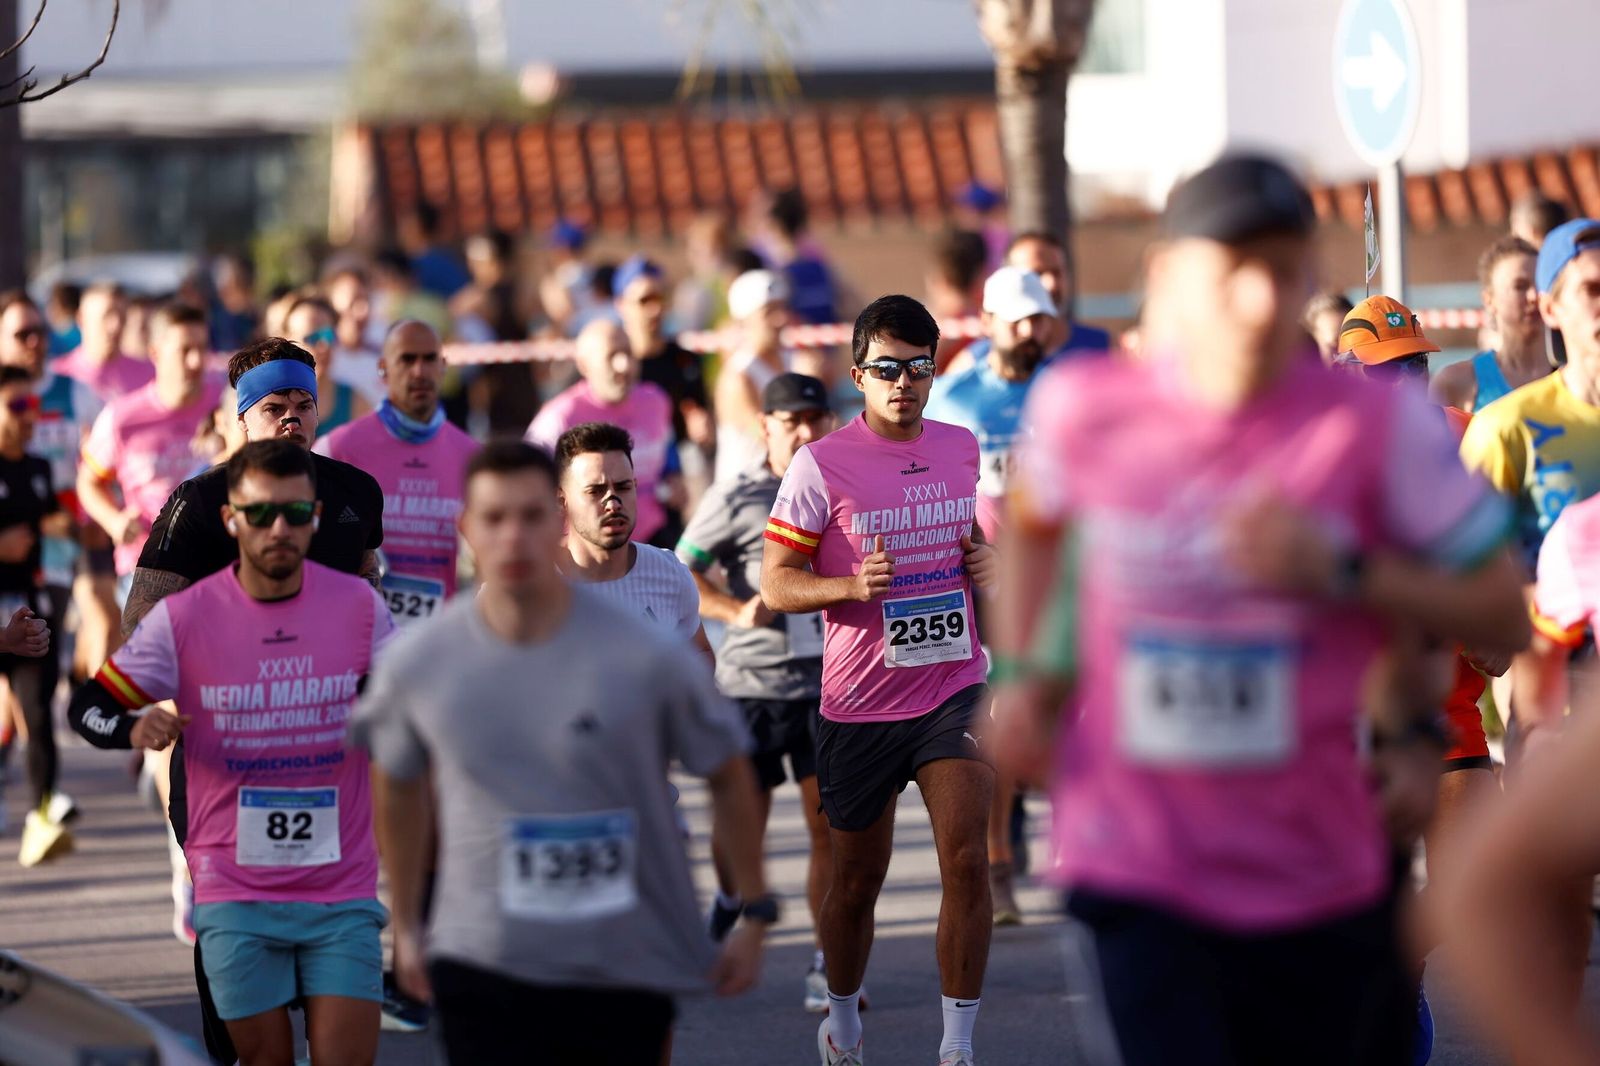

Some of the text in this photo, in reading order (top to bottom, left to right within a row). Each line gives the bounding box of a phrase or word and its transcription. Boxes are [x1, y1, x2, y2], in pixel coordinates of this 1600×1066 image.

[903, 481, 948, 503] XXXVI
[851, 493, 976, 535] MEDIA MARATÓ
[862, 525, 958, 553] INERNACIONAL
[895, 552, 934, 566] ERNATIONAL
[889, 565, 967, 588] RREMOLINO
[890, 612, 964, 646] 2359
[258, 655, 313, 680] XXXVI
[201, 668, 358, 711] MEDIA MARATÓ
[213, 707, 322, 732] INTERNACIONAL
[267, 811, 313, 840] 82
